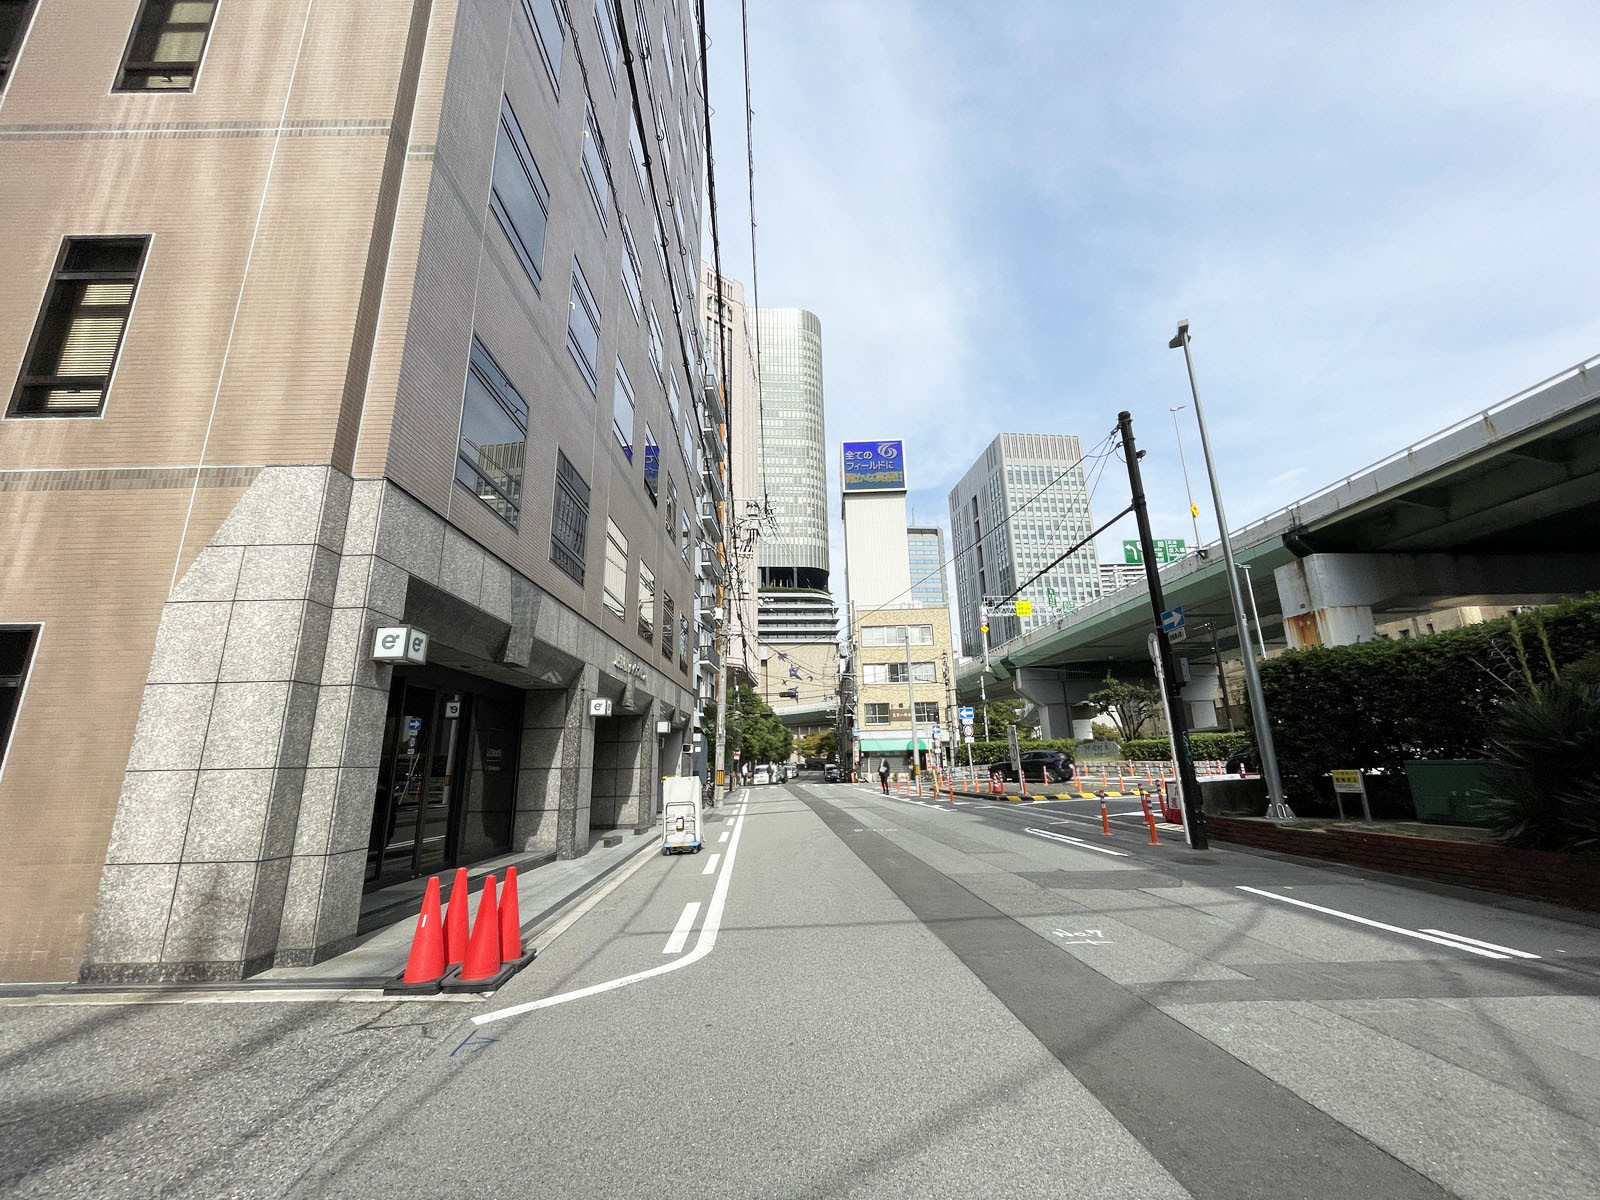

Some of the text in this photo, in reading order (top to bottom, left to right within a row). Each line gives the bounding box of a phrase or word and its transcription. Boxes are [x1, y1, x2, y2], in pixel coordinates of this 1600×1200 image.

[845, 451, 873, 460] 全ての
[846, 461, 894, 471] フィールドに
